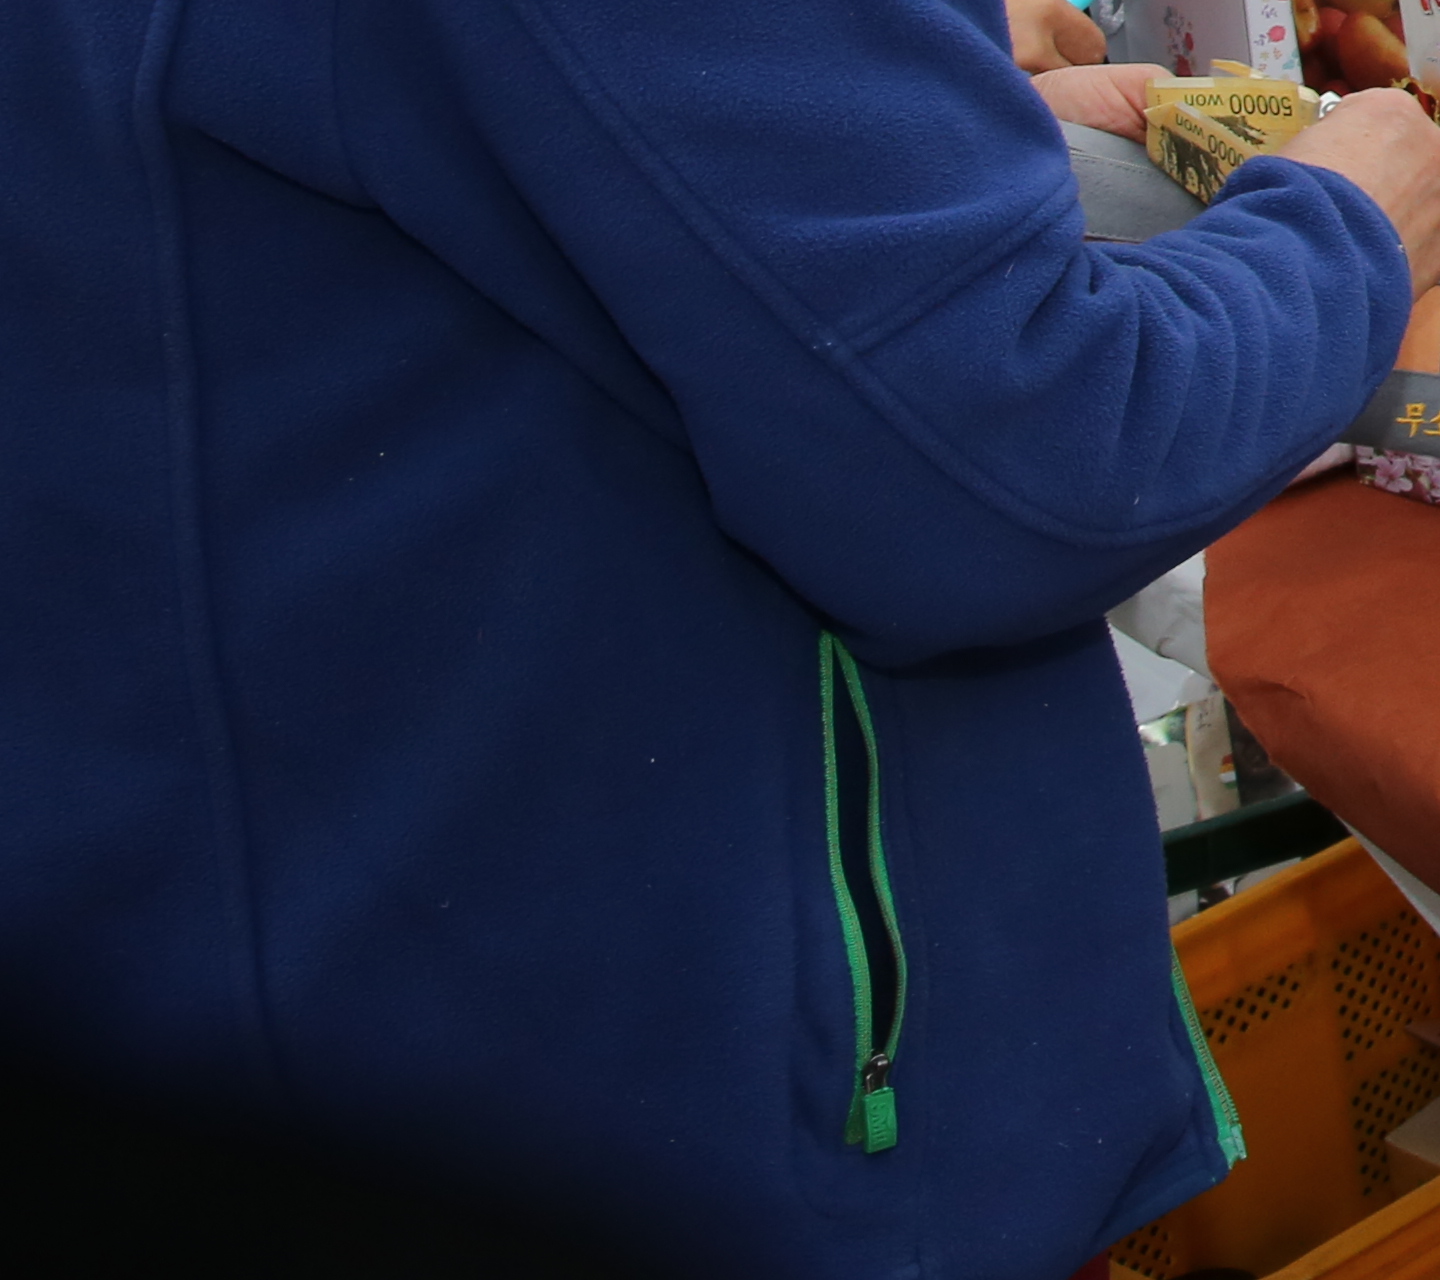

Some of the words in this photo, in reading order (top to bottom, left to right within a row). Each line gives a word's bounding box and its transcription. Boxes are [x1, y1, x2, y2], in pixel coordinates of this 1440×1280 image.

[1184, 93, 1224, 107] won
[1229, 93, 1293, 118] 50000
[1175, 113, 1207, 141] won
